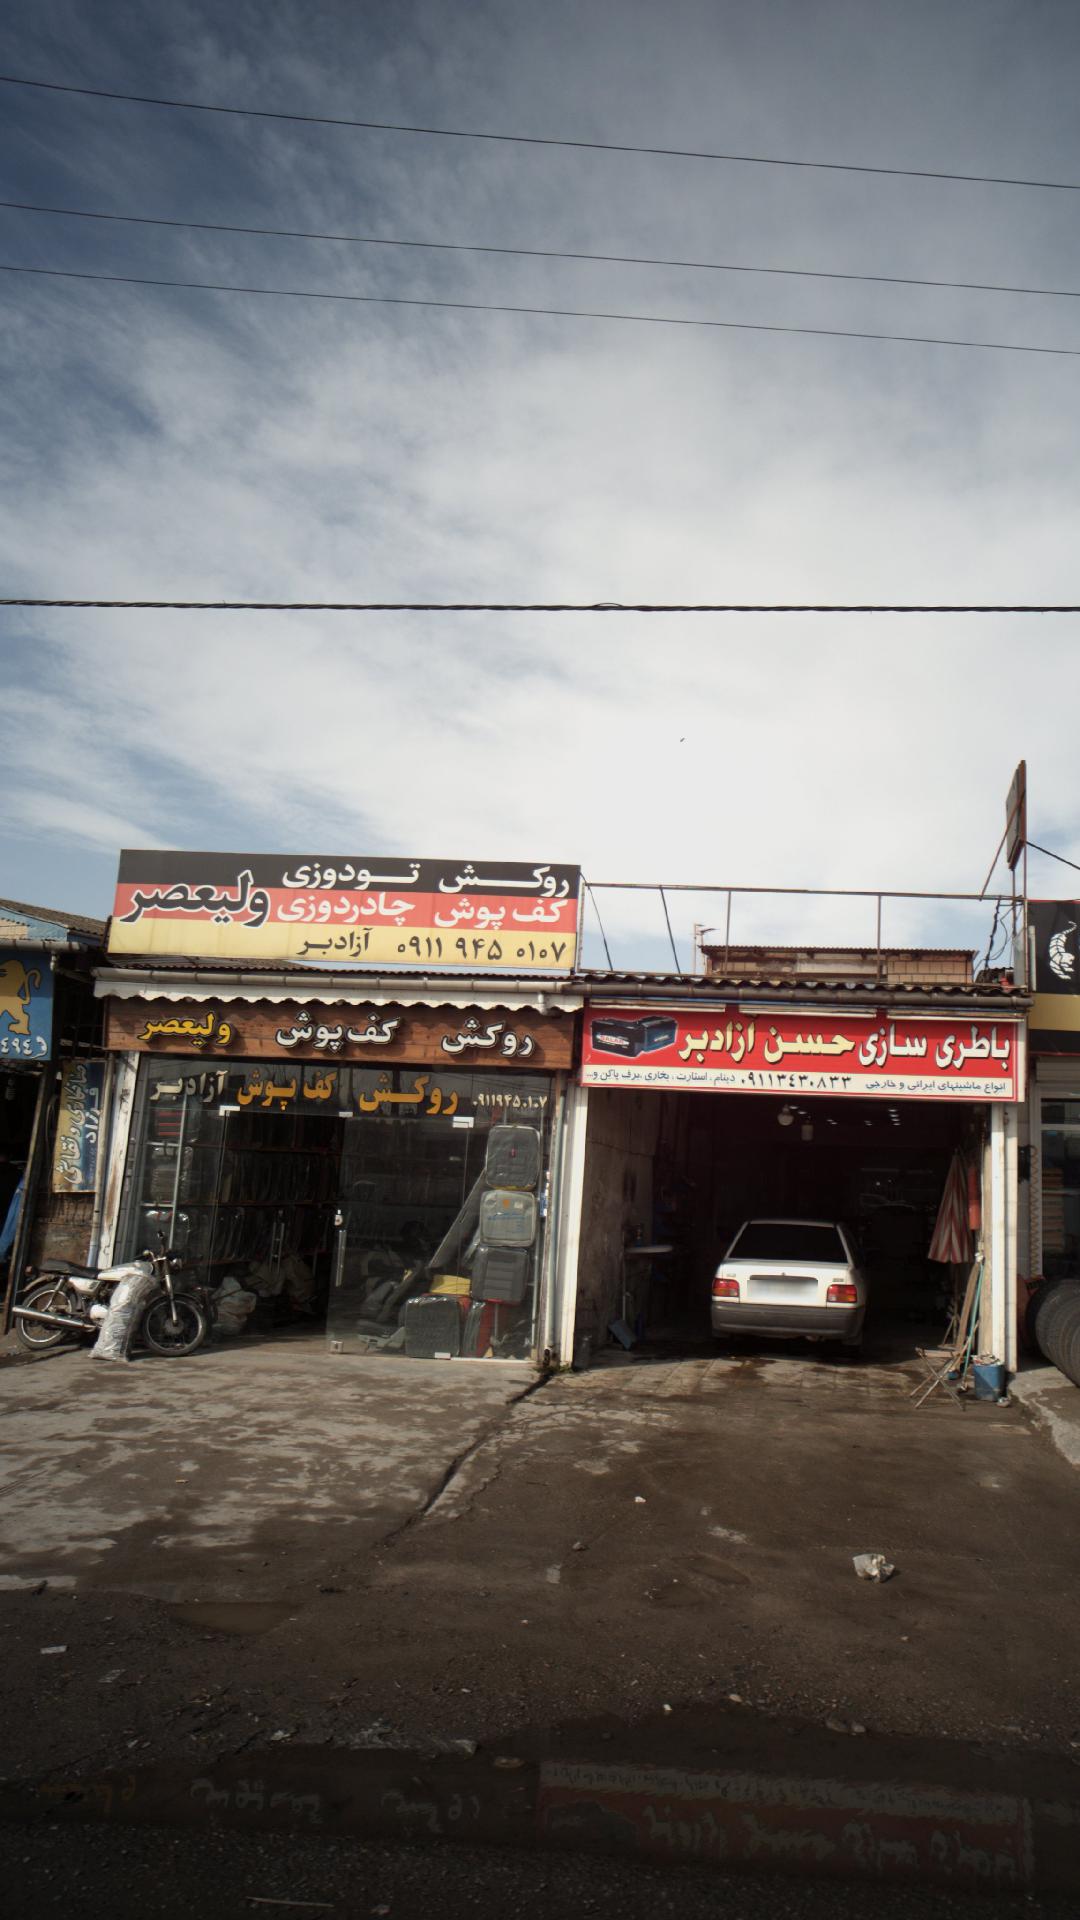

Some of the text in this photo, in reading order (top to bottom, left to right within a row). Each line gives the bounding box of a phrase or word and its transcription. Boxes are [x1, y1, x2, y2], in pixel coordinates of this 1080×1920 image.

[119, 869, 272, 927] ولیعصر
[281, 863, 570, 898] روکش تودوزی
[276, 892, 568, 932] کف پوش چادردوزی
[296, 927, 372, 955] آزادبر
[138, 1013, 232, 1045] ولیعصر
[275, 1010, 401, 1054] کف پوش
[441, 1017, 536, 1057] روکش
[764, 1025, 855, 1064] حسن
[858, 1022, 928, 1065] سازی
[935, 1025, 1010, 1068] باطری
[150, 1070, 229, 1103] آزادبر
[237, 1069, 337, 1111] کف پوش
[359, 1072, 458, 1115] روکش
[865, 1080, 896, 1090] خارجی
[907, 1080, 935, 1091] ایرانی
[984, 1082, 1006, 1093] انواع
[85, 1087, 100, 1143] فرزاد
